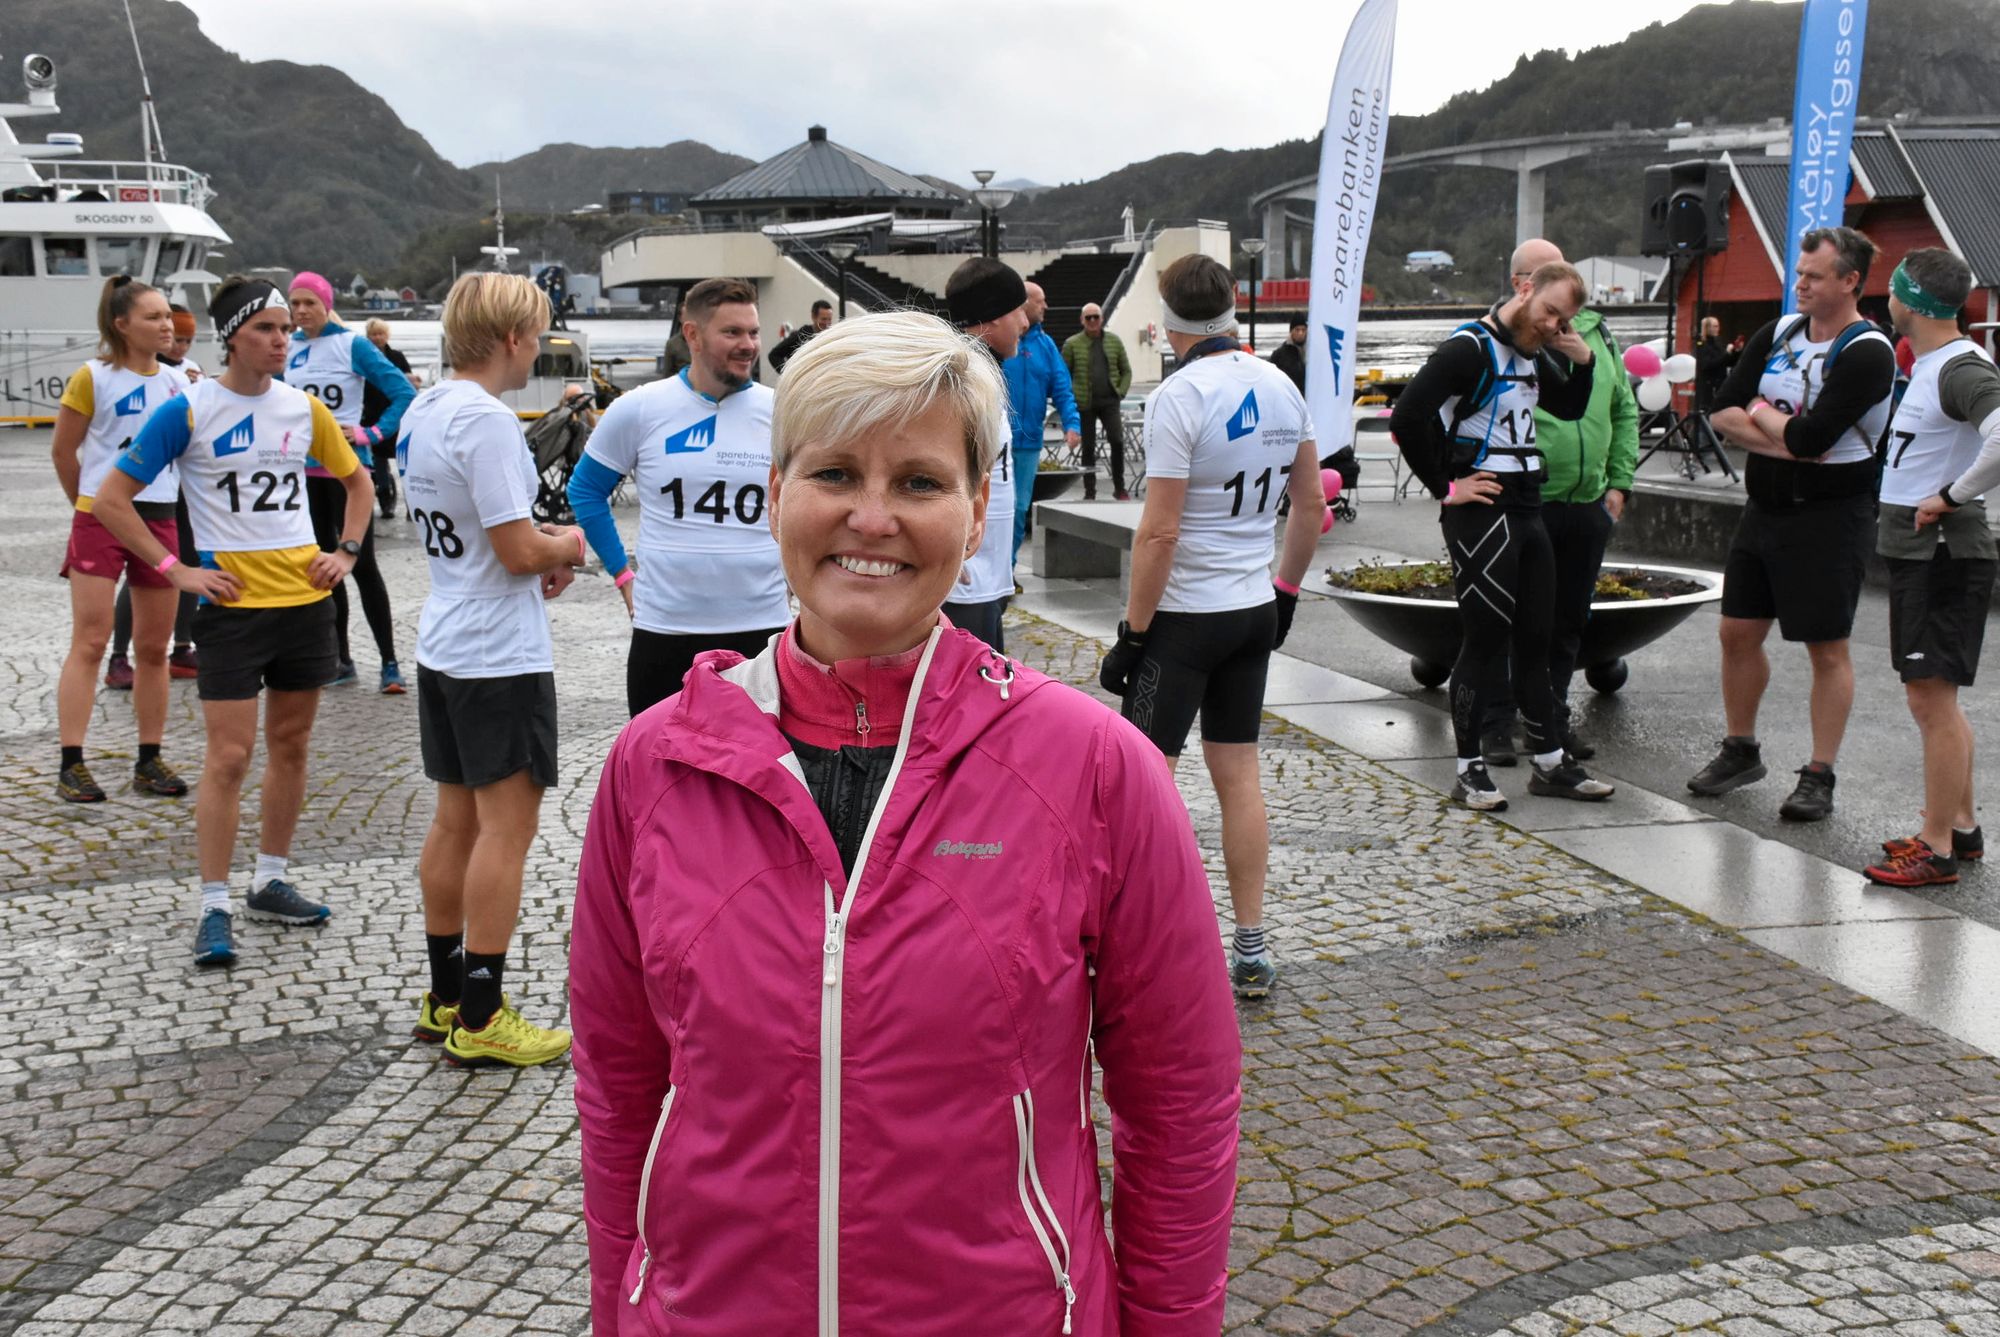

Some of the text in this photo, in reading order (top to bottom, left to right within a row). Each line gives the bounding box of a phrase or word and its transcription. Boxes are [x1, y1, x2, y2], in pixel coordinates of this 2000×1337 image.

[1816, 0, 1853, 231] reningsse
[1799, 103, 1828, 237] Måløy
[75, 214, 154, 224] SKOGSØY 50
[1333, 87, 1366, 304] sparebanken
[716, 450, 771, 463] sparebanke
[216, 470, 302, 513] 122
[660, 477, 765, 525] 140
[1223, 464, 1293, 517] 117
[414, 507, 464, 559] 28
[932, 839, 1003, 860] Bergans
